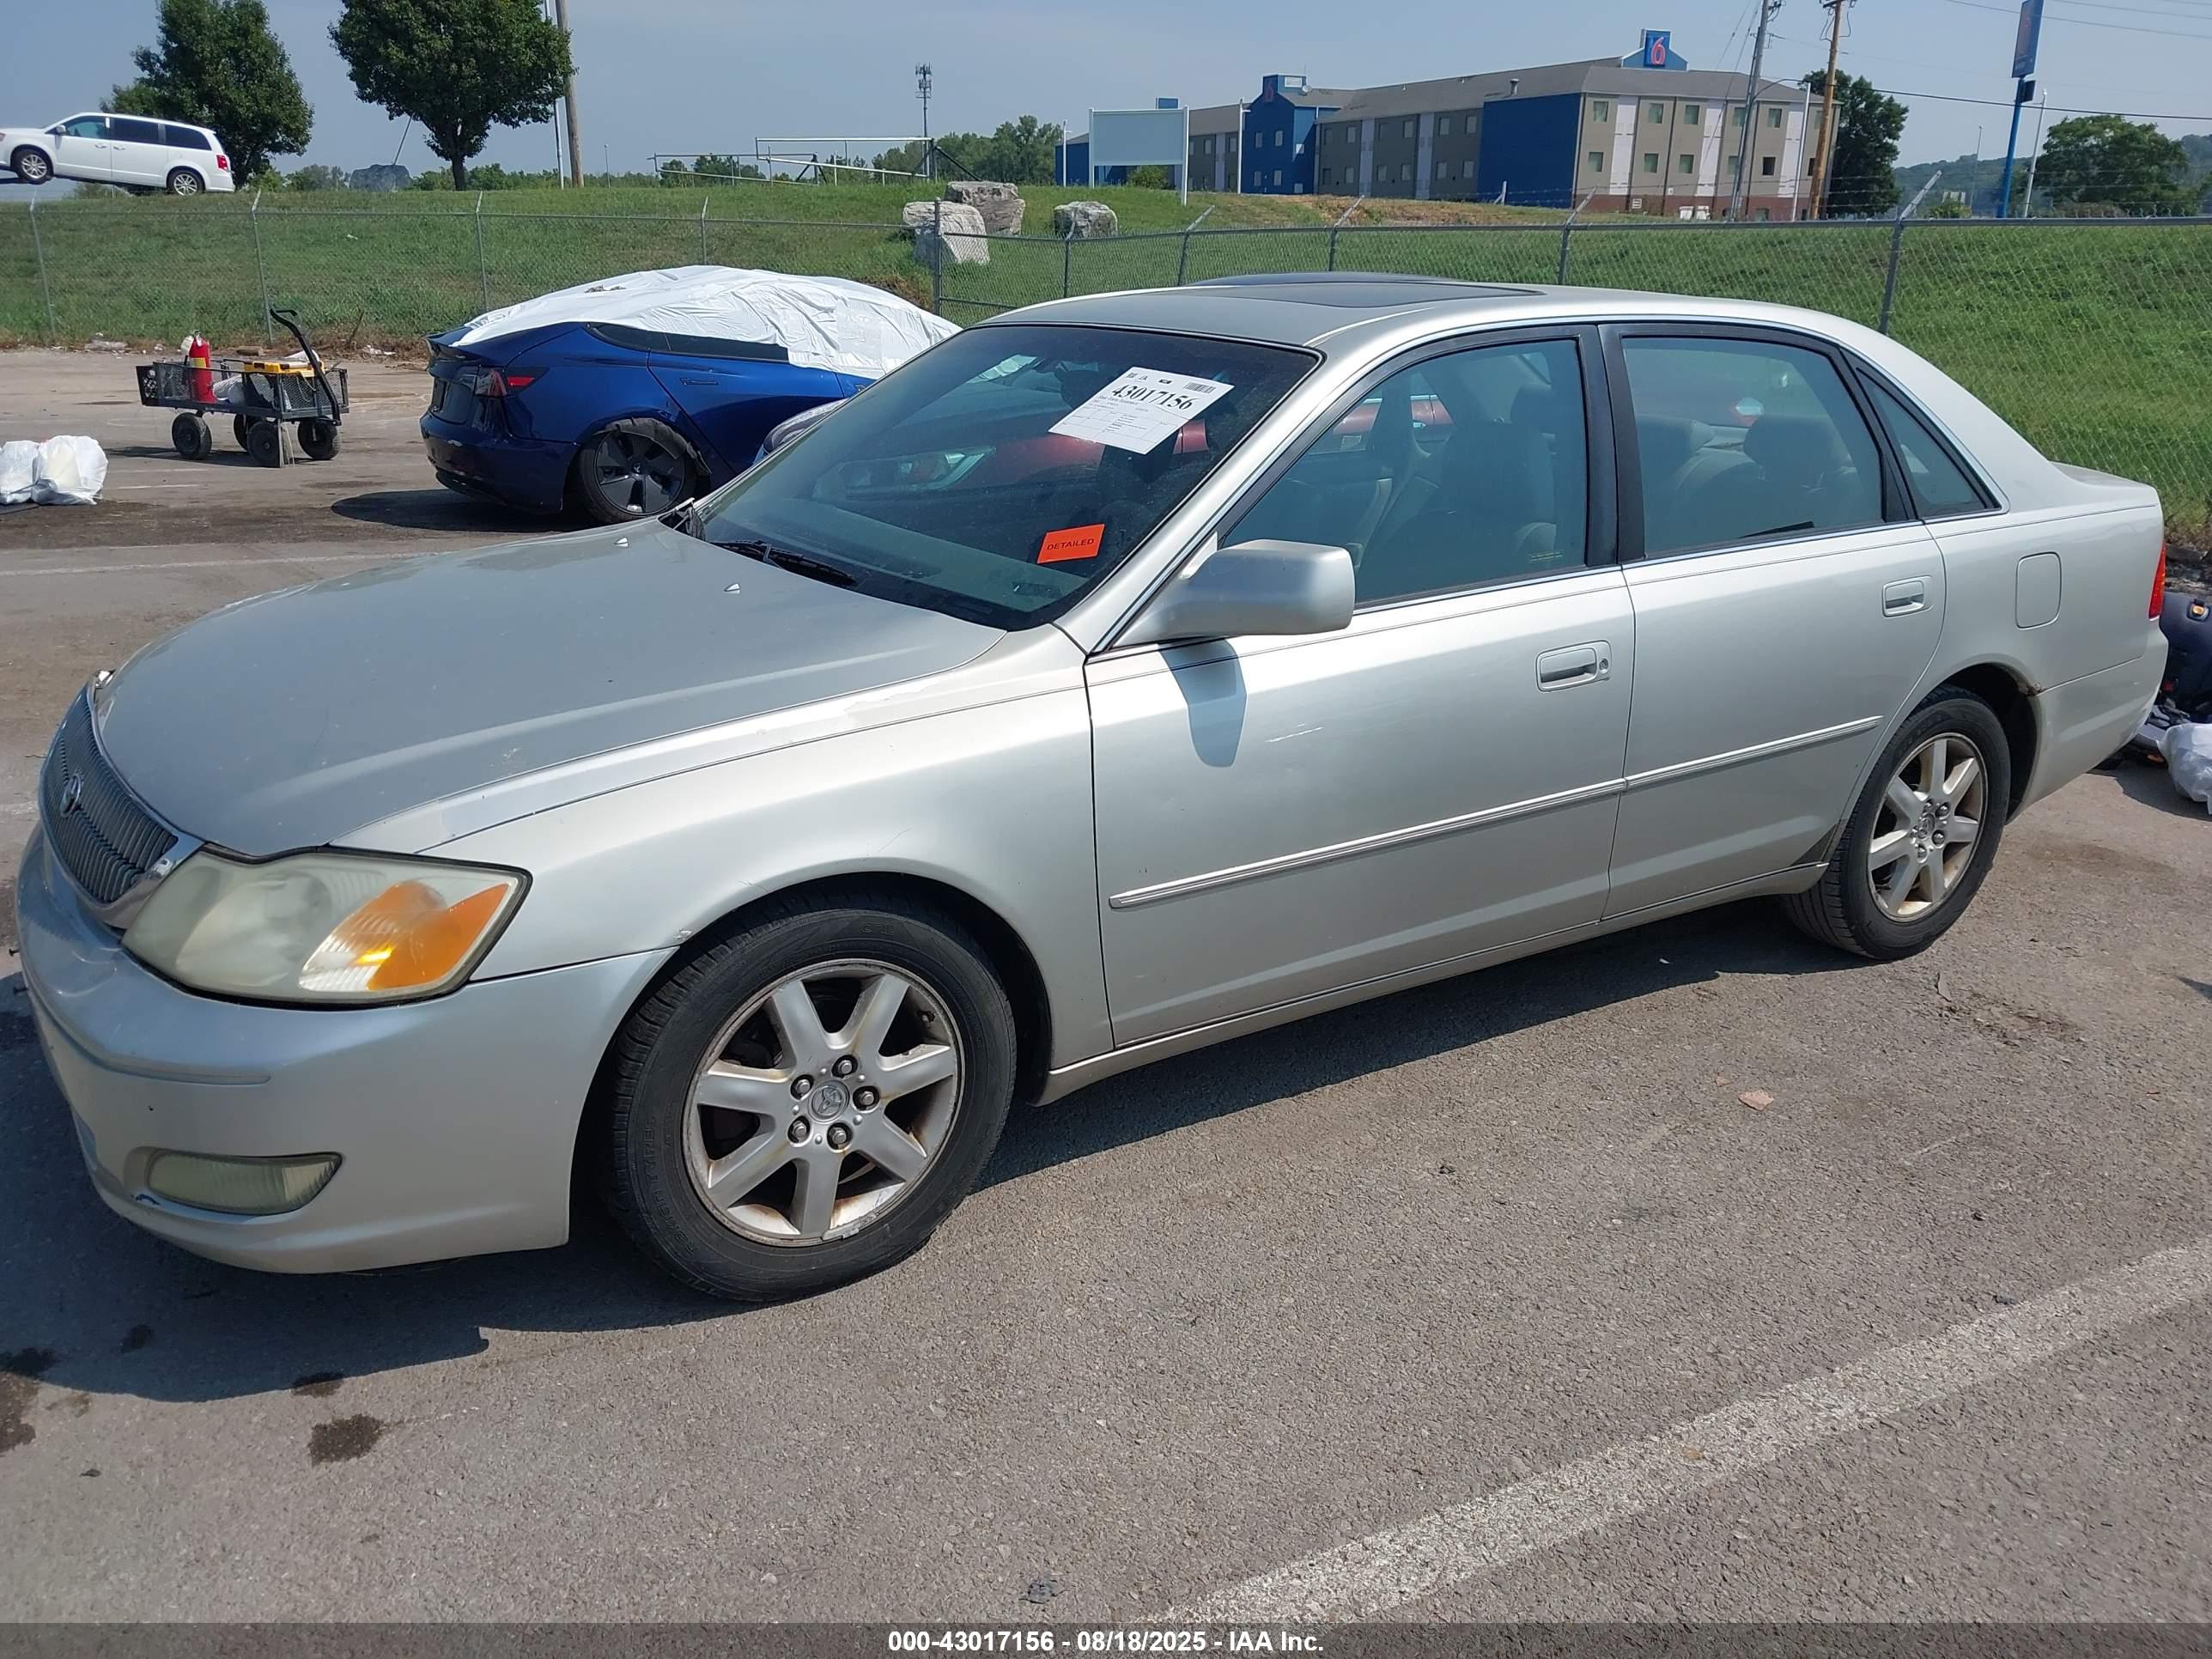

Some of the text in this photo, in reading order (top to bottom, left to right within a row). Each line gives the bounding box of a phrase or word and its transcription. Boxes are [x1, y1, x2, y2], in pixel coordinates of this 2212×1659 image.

[1650, 36, 1665, 64] 6
[1112, 384, 1200, 410] 43017156
[1047, 538, 1095, 550] DETAILED
